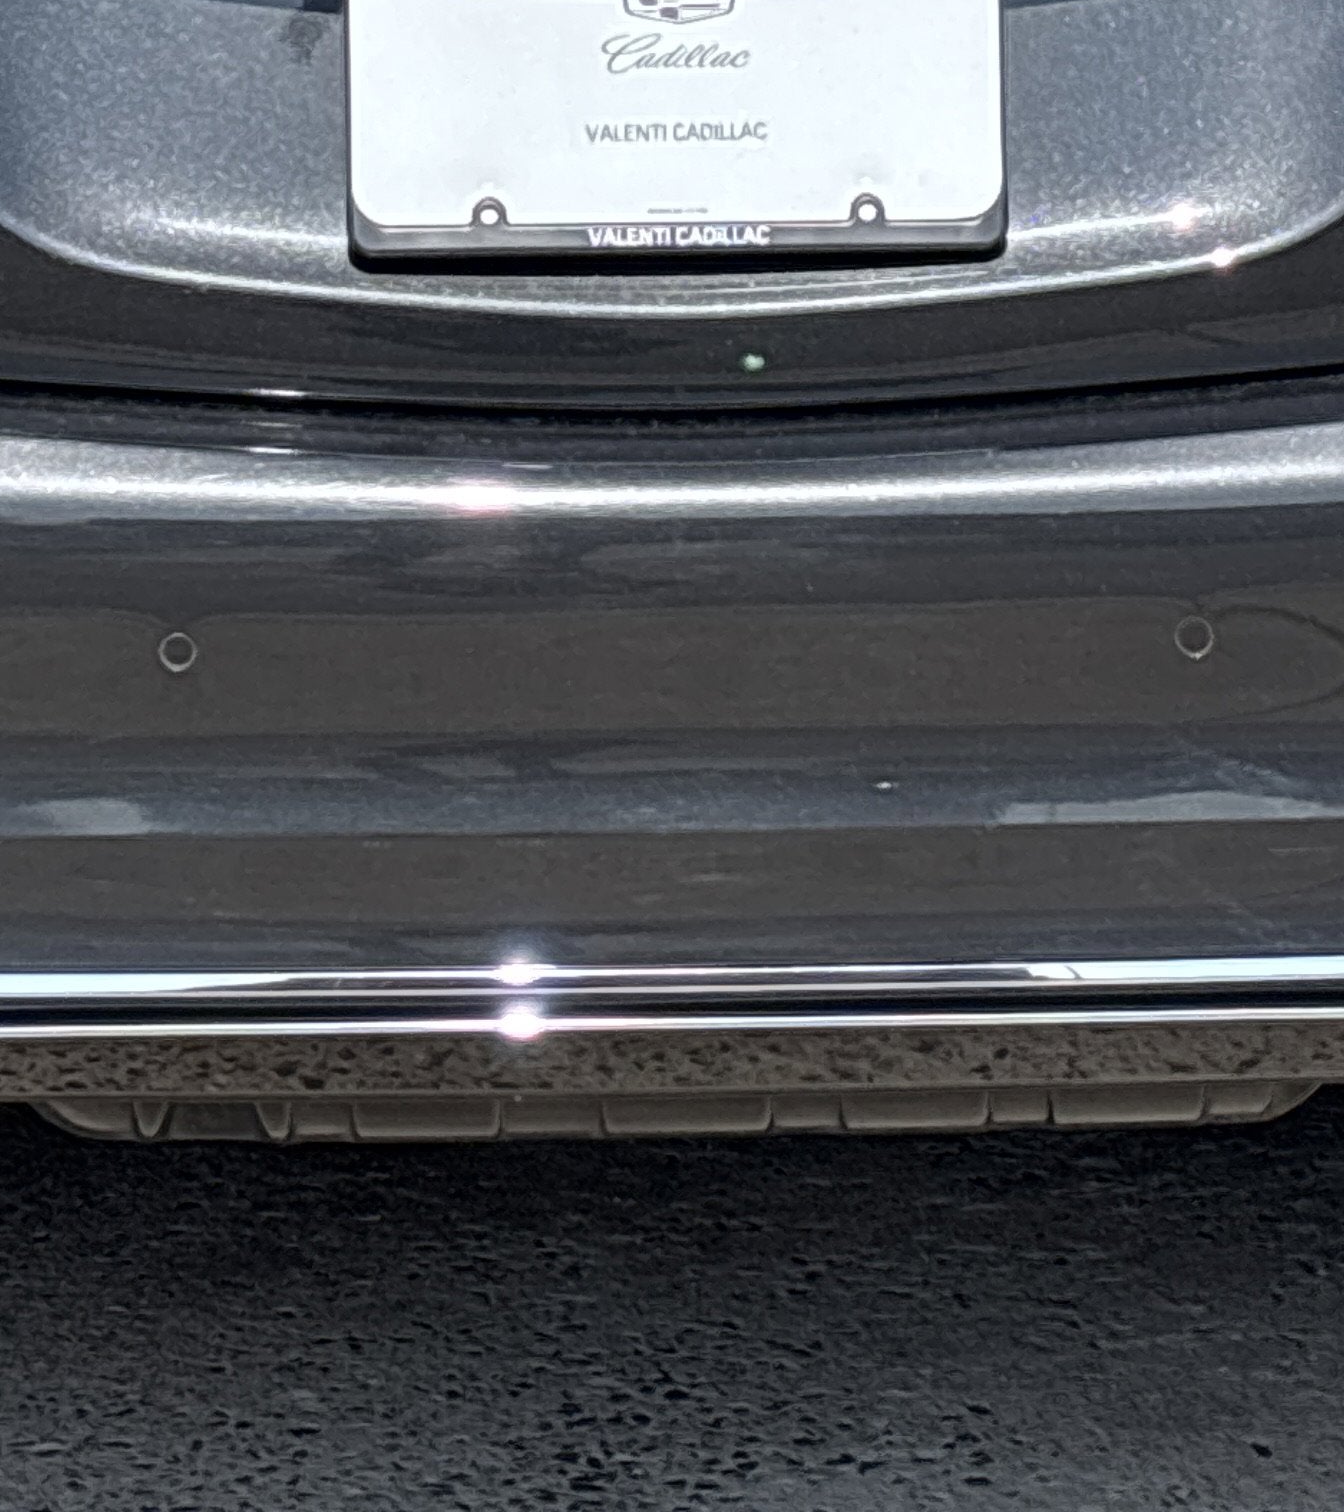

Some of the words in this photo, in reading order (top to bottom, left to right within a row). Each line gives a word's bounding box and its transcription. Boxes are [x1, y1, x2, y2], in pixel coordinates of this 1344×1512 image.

[601, 32, 751, 74] Cadillac
[584, 123, 667, 142] VALENTI
[672, 121, 769, 141] CADILLAC
[587, 226, 670, 247] VALENTI
[675, 224, 772, 247] CADILLAC
